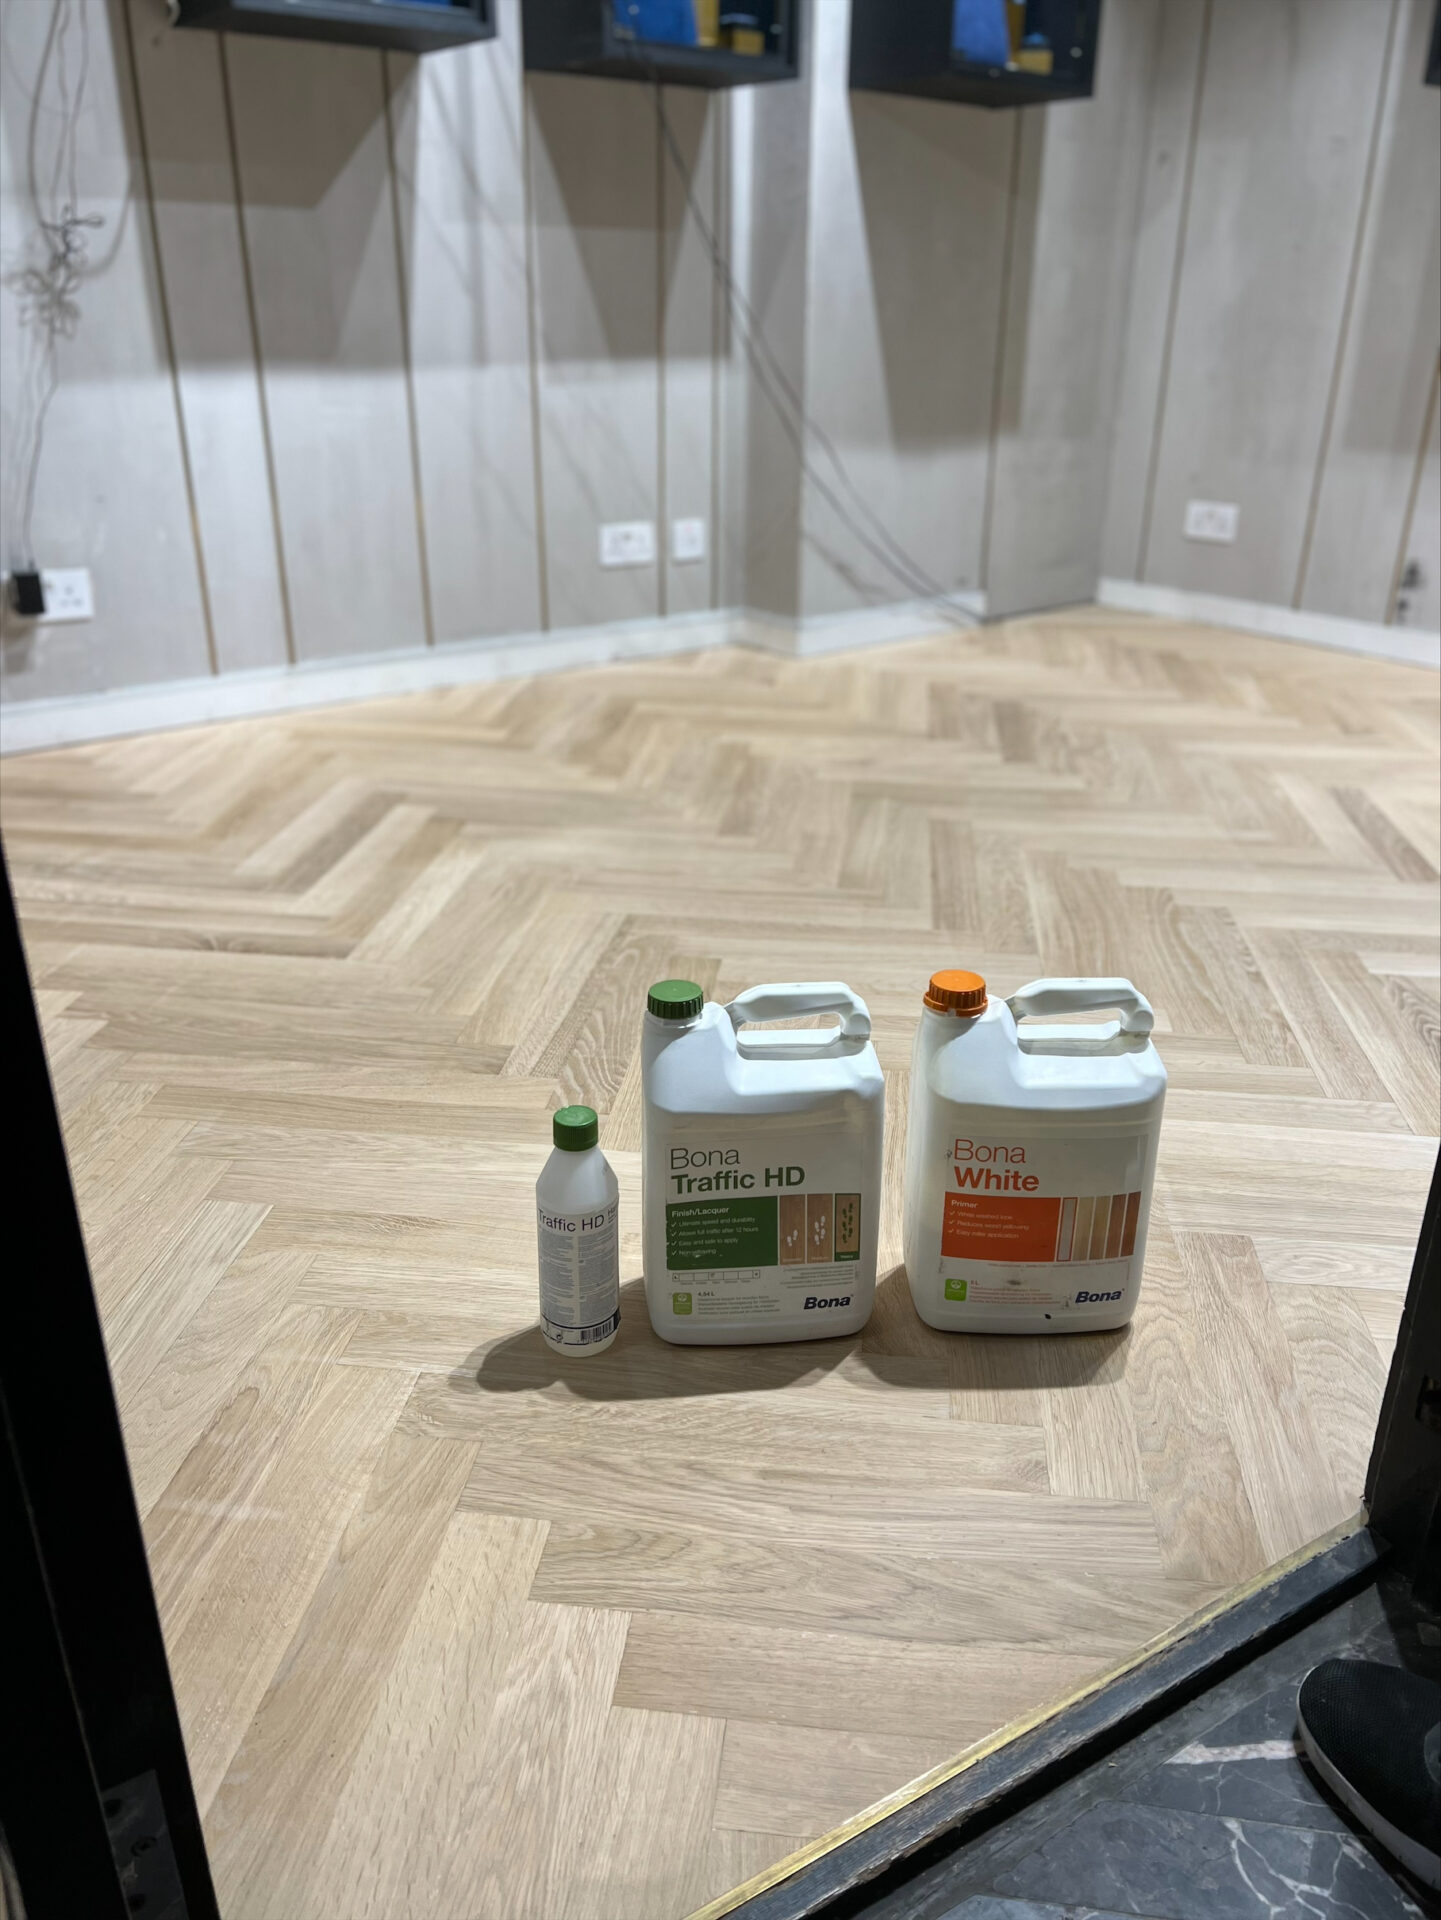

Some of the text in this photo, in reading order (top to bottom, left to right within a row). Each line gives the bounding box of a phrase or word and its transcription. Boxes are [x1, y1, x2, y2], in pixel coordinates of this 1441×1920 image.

[670, 1147, 740, 1170] Bona
[954, 1138, 1026, 1164] Bona
[671, 1166, 805, 1195] Traffic HD
[954, 1165, 1040, 1192] White
[671, 1207, 729, 1218] Finish/Lacquer
[951, 1200, 978, 1209] Primer
[538, 1207, 576, 1232] Traffic
[582, 1214, 605, 1231] HD
[803, 1296, 851, 1310] Bona
[1075, 1290, 1122, 1304] Bona
